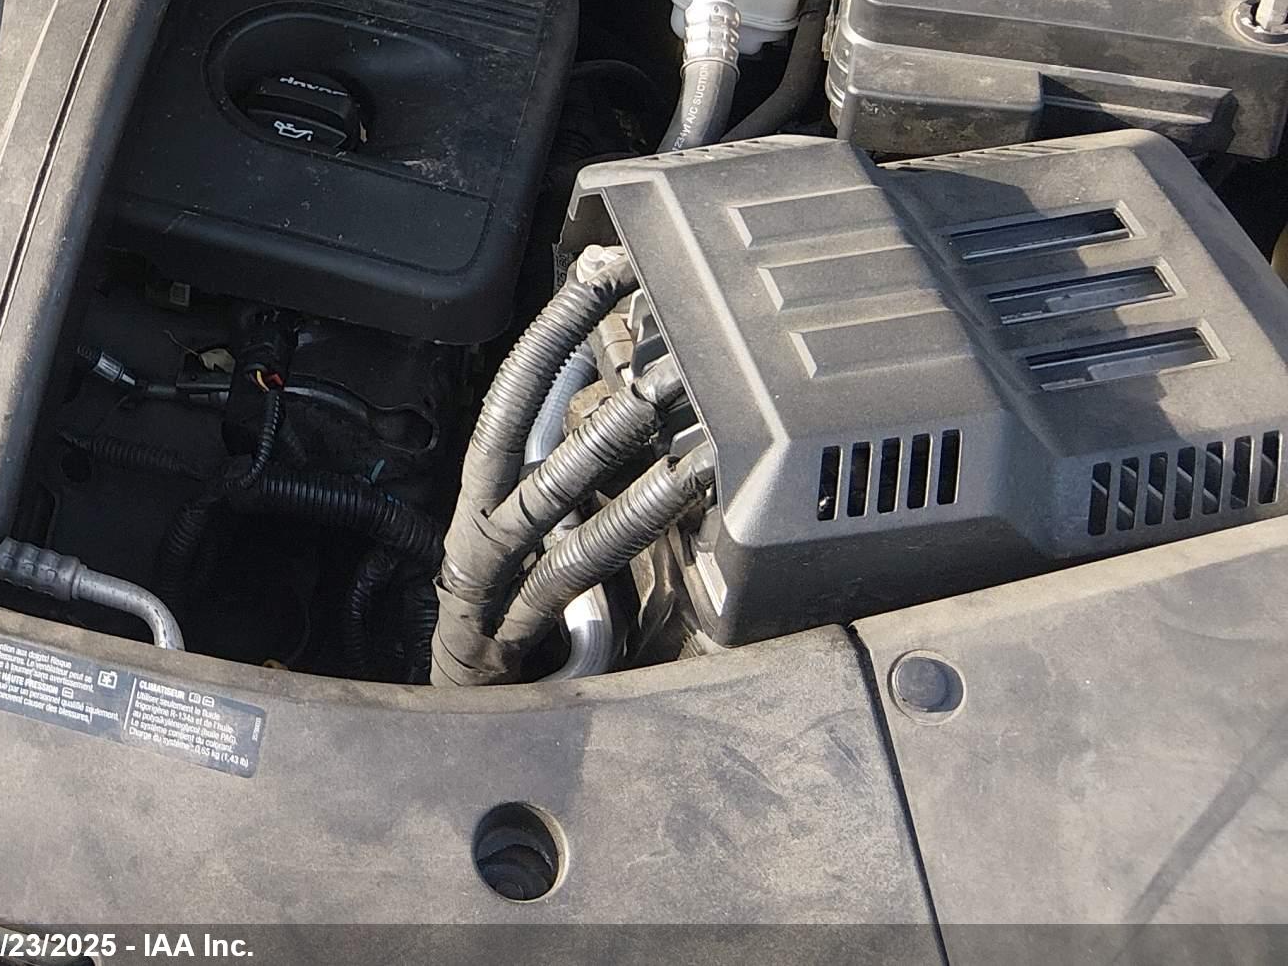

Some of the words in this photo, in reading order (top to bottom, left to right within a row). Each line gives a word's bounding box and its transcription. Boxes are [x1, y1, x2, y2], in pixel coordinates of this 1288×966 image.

[686, 106, 698, 124] A/C
[2, 672, 25, 685] HAUTE
[25, 679, 59, 695] PRESSION
[139, 680, 185, 699] CLIMATISEUR
